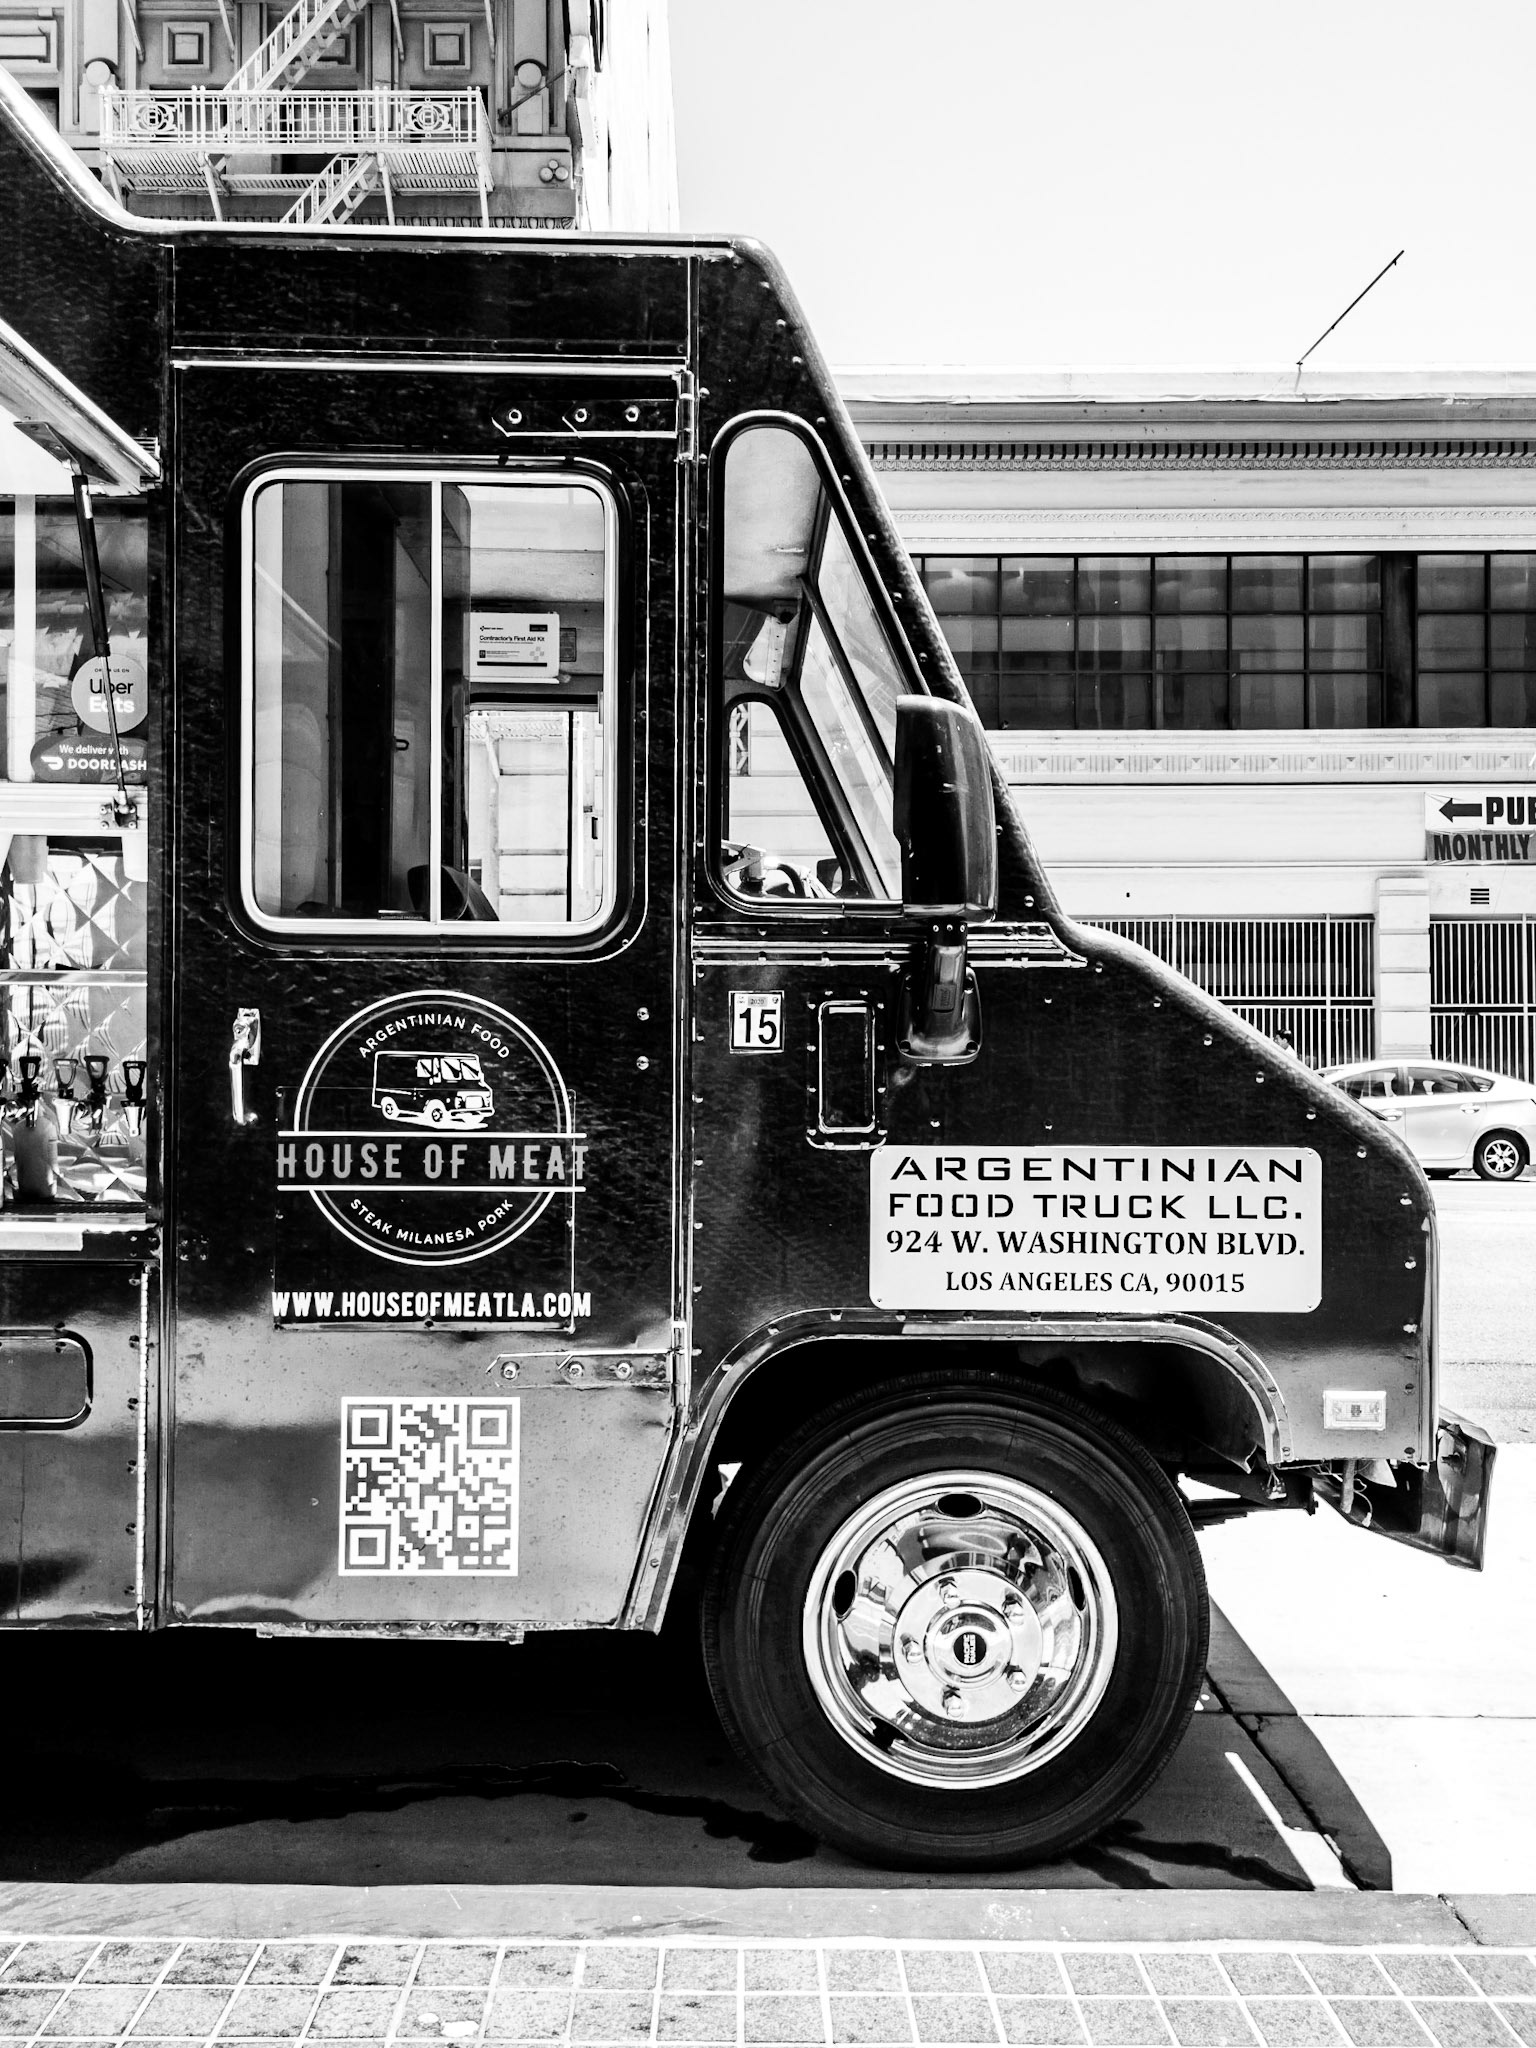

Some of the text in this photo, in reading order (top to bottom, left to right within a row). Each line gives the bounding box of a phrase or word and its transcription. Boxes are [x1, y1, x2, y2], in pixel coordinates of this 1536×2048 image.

[59, 745, 129, 755] We deliver wth
[68, 759, 147, 770] DOORDASH
[1433, 834, 1530, 860] MONTHLY
[359, 1013, 510, 1058] ARGENTINIAN FOOD
[739, 1008, 777, 1044] 15
[276, 1143, 589, 1180] HOUSE OF MEAT
[890, 1156, 1302, 1183] ARGENTINIAN
[889, 1193, 1302, 1219] FOOD TRUCK LLC.
[350, 1199, 513, 1244] STEAK MILANESA PORK
[886, 1230, 1305, 1255] 924 W. WASHINGTON BLVD.
[946, 1271, 1245, 1295] LOS ANGELES CA, 90015
[271, 1292, 591, 1317] WWW.HOUSEOFMEATLA.COM
